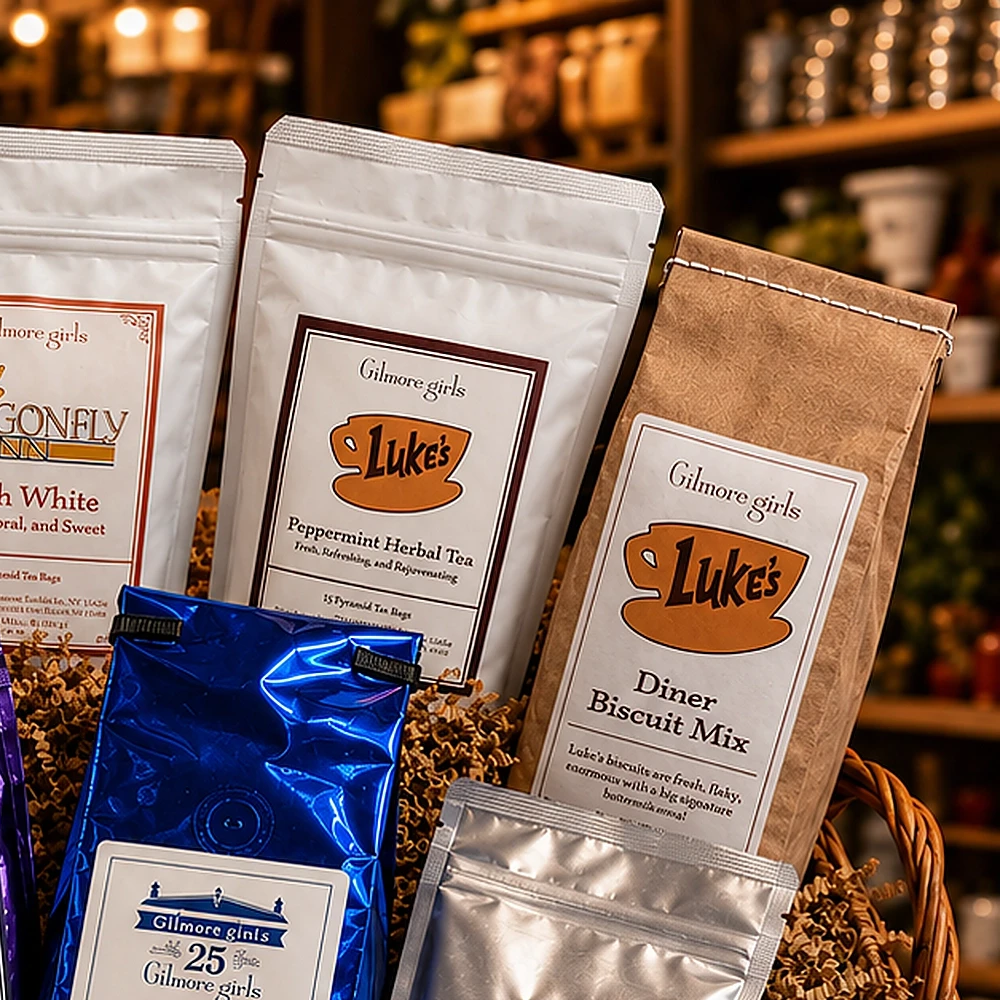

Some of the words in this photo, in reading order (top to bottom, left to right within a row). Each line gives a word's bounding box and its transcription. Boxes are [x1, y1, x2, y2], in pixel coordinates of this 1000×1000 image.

[46, 321, 89, 350] girls
[358, 356, 424, 390] Gilmore
[424, 374, 467, 403] girls
[20, 485, 100, 513] White
[668, 459, 748, 506] Gilmore
[745, 491, 802, 524] girls
[31, 519, 59, 534] and
[62, 520, 106, 537] Sweet
[287, 516, 380, 550] Peppermint
[384, 536, 442, 562] Herbal
[446, 548, 474, 568] Tea
[633, 669, 718, 714] Diner
[587, 689, 685, 736] Biscuit
[689, 718, 750, 755] Mix
[143, 960, 215, 995] Gilmore
[184, 943, 227, 975] 25
